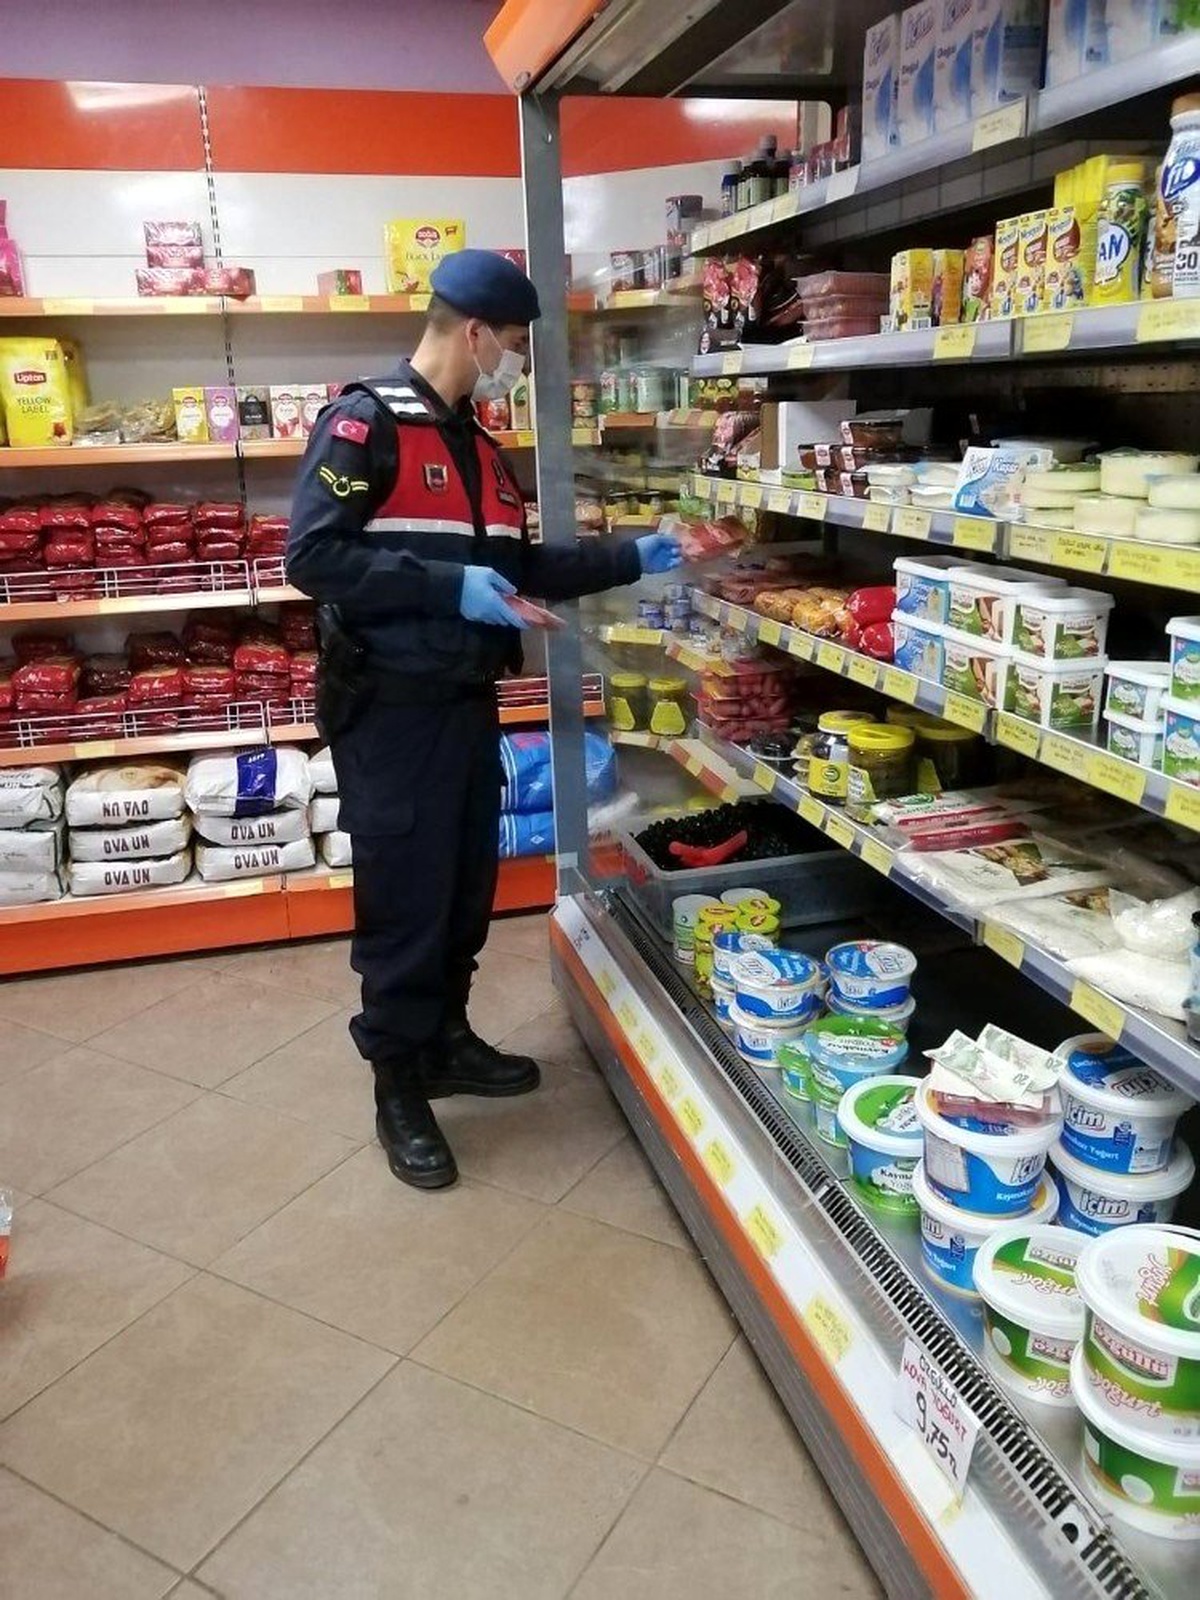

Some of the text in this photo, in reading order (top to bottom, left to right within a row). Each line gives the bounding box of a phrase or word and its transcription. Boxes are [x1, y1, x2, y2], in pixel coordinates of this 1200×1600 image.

[16, 373, 45, 383] Lipton
[16, 396, 51, 405] YELLOW
[21, 404, 50, 413] LABEL
[230, 821, 275, 841] OVA UN
[103, 834, 150, 854] OVA UN
[233, 848, 279, 870] OVA UN
[103, 868, 150, 886] OVA UN
